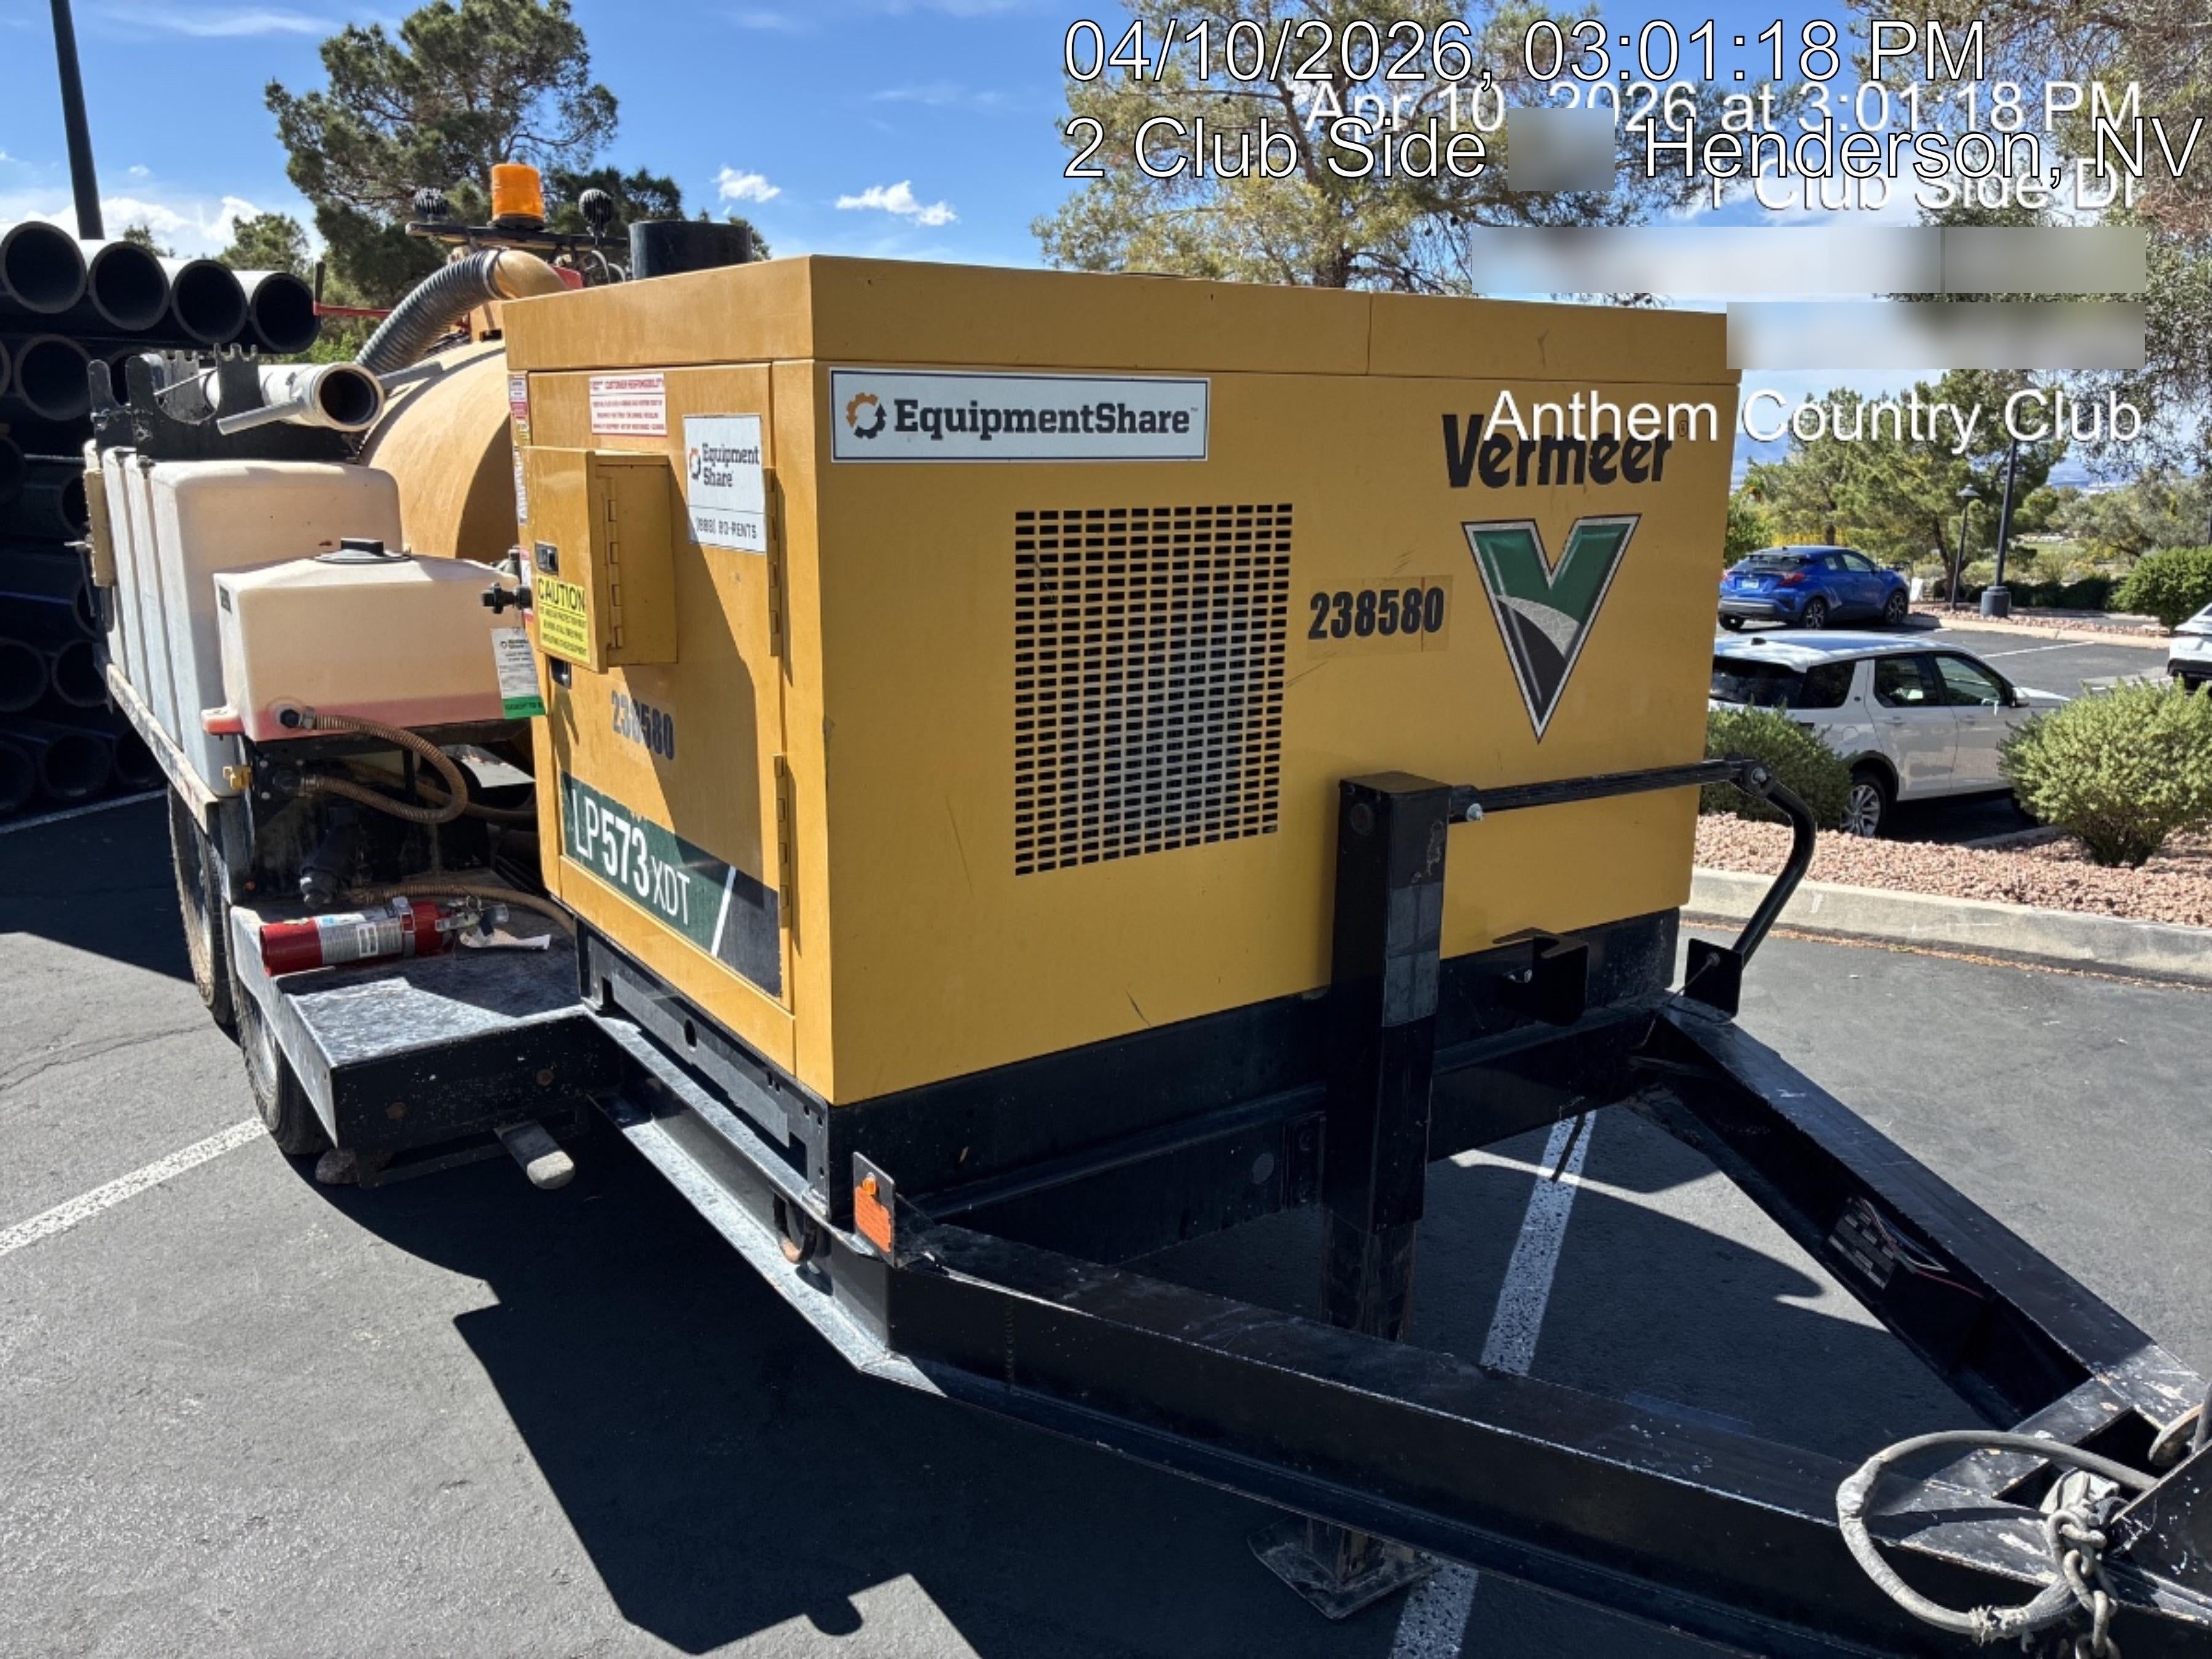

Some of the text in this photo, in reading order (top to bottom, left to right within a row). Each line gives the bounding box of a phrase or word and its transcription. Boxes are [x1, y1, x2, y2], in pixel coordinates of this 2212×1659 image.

[894, 399, 1191, 441] EquipmentShare
[702, 442, 760, 469] Equipment
[1441, 414, 1673, 488] Vermeer
[703, 468, 733, 487] Share
[537, 577, 586, 613] CAUTION
[1308, 587, 1444, 640] 238580
[611, 690, 674, 761] 238580
